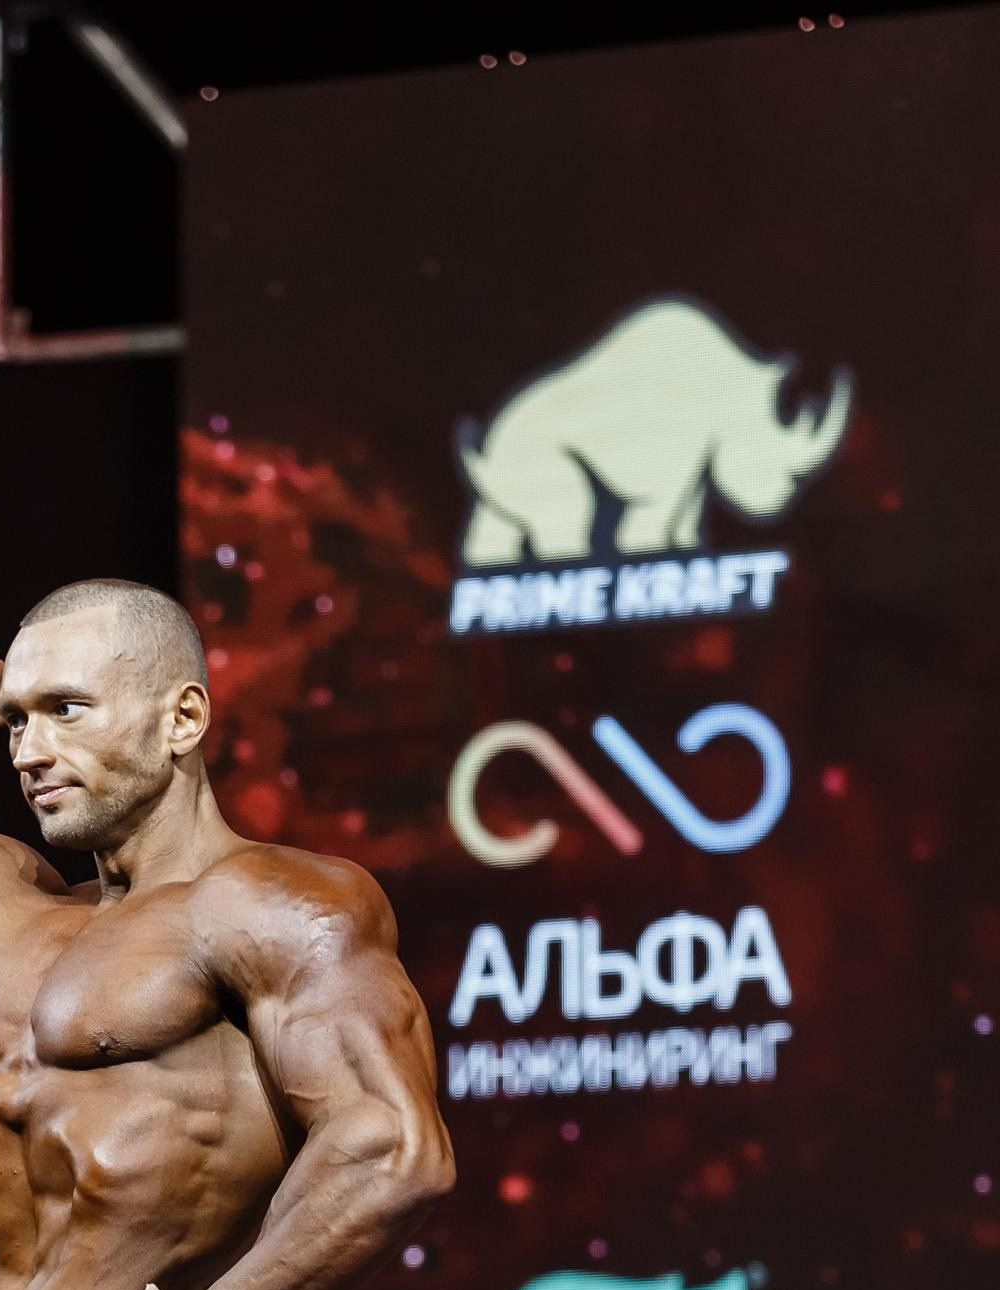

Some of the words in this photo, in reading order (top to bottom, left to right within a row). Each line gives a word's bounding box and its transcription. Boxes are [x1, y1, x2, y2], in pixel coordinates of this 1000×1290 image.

[451, 568, 612, 633] PRIME
[614, 551, 790, 618] KRAFT
[449, 905, 793, 1027] АЛЬФА
[449, 1021, 793, 1099] ИНЖИНИРИНГ
